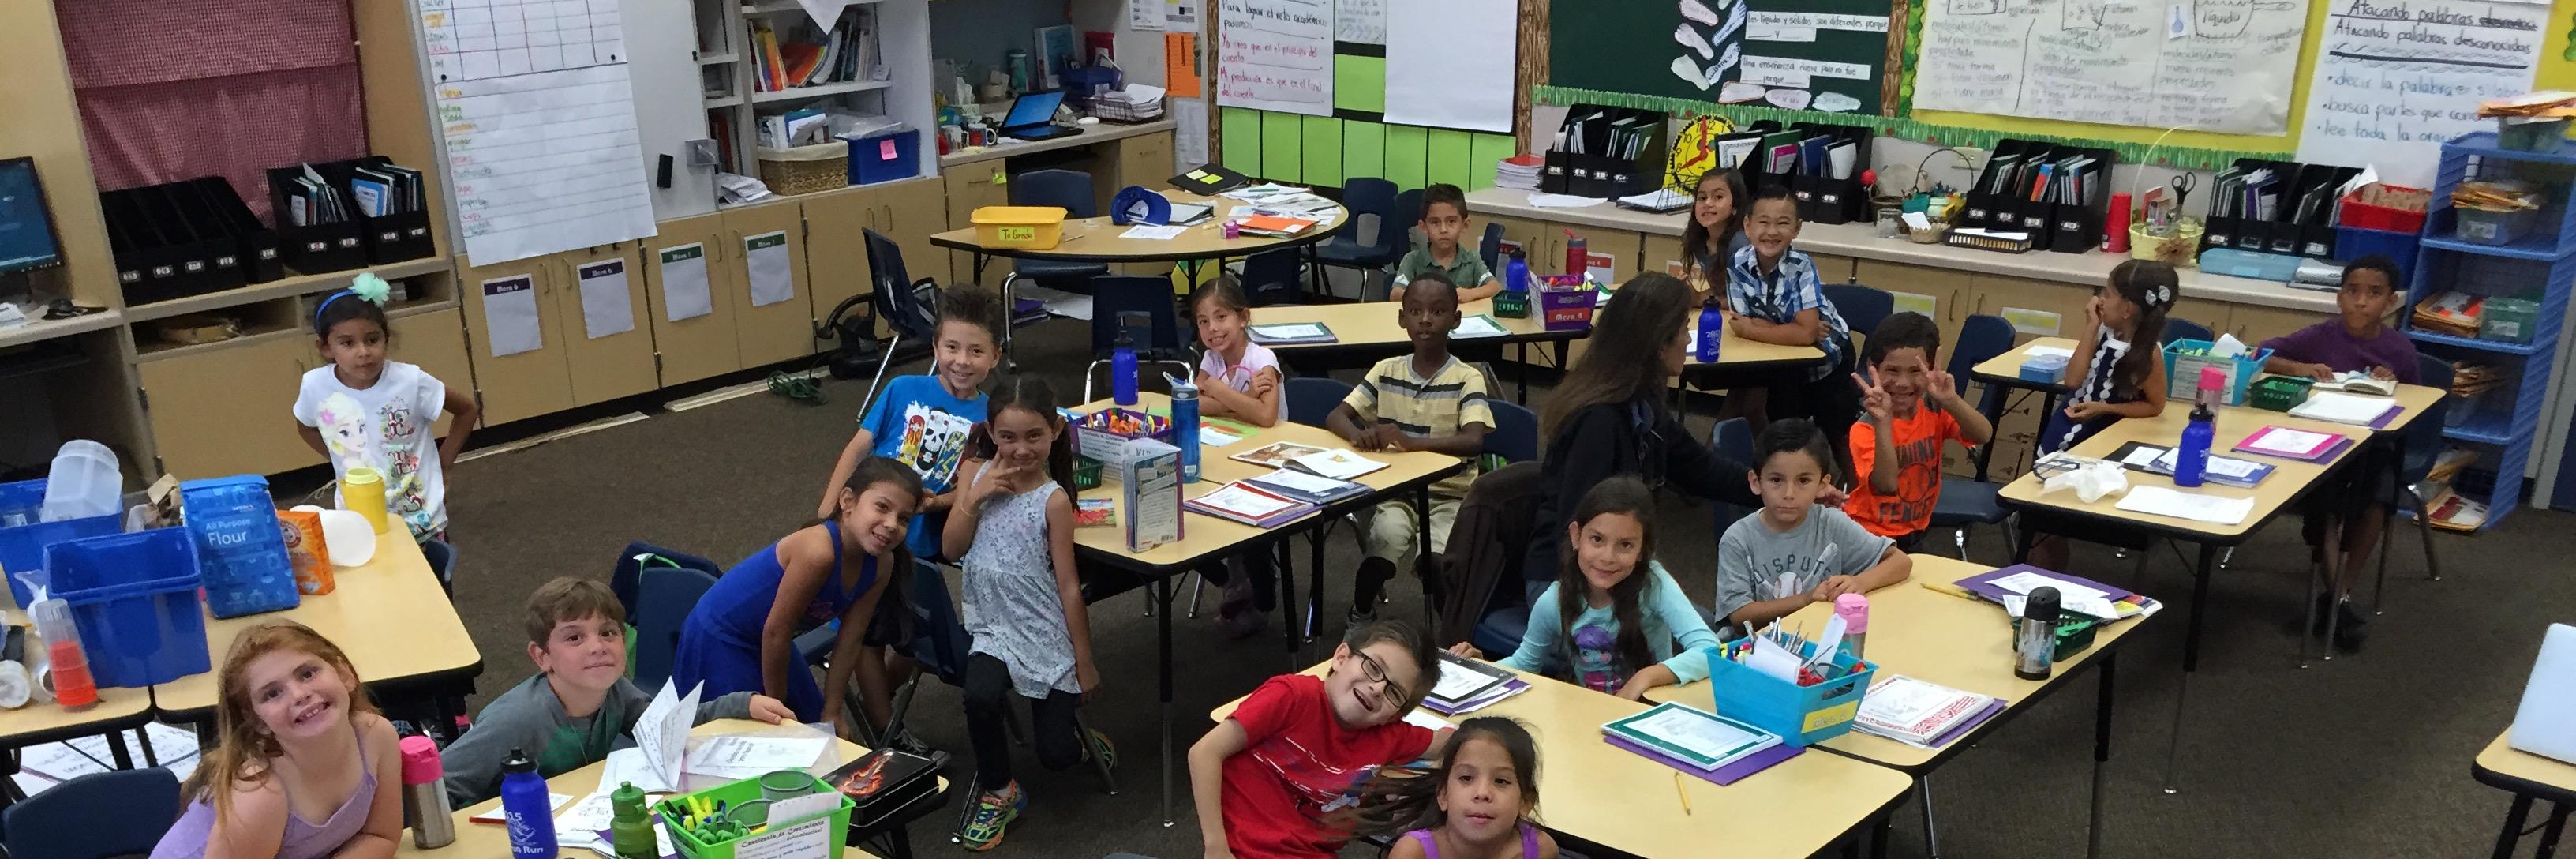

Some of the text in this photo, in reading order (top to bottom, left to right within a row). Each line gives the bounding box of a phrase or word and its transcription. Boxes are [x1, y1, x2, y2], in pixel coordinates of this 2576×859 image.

[1267, 7, 1273, 18] el
[1748, 13, 1758, 23] Los
[2346, 0, 2410, 19] Atacando
[2417, 7, 2473, 24] palabras
[2203, 12, 2241, 26] líquido
[2334, 18, 2390, 39] Atacando
[2397, 25, 2447, 44] palabras
[1251, 44, 1261, 54] que
[1308, 47, 1317, 58] del
[1743, 58, 1755, 69] Una
[1277, 79, 1287, 89] que
[2335, 69, 2371, 87] decir
[2381, 72, 2393, 89] la
[2400, 76, 2452, 96] palabra
[2328, 96, 2370, 115] busca
[2376, 102, 2416, 121] partes
[2421, 108, 2444, 122] que
[1708, 120, 1716, 130] 12
[2324, 119, 2346, 137] lee
[2355, 122, 2387, 141] toda
[2398, 122, 2409, 141] la
[1683, 133, 1692, 144] 10
[1676, 147, 1682, 156] 9
[1002, 228, 1010, 240] To
[206, 519, 251, 531] All Purpose
[208, 531, 247, 546] Flour
